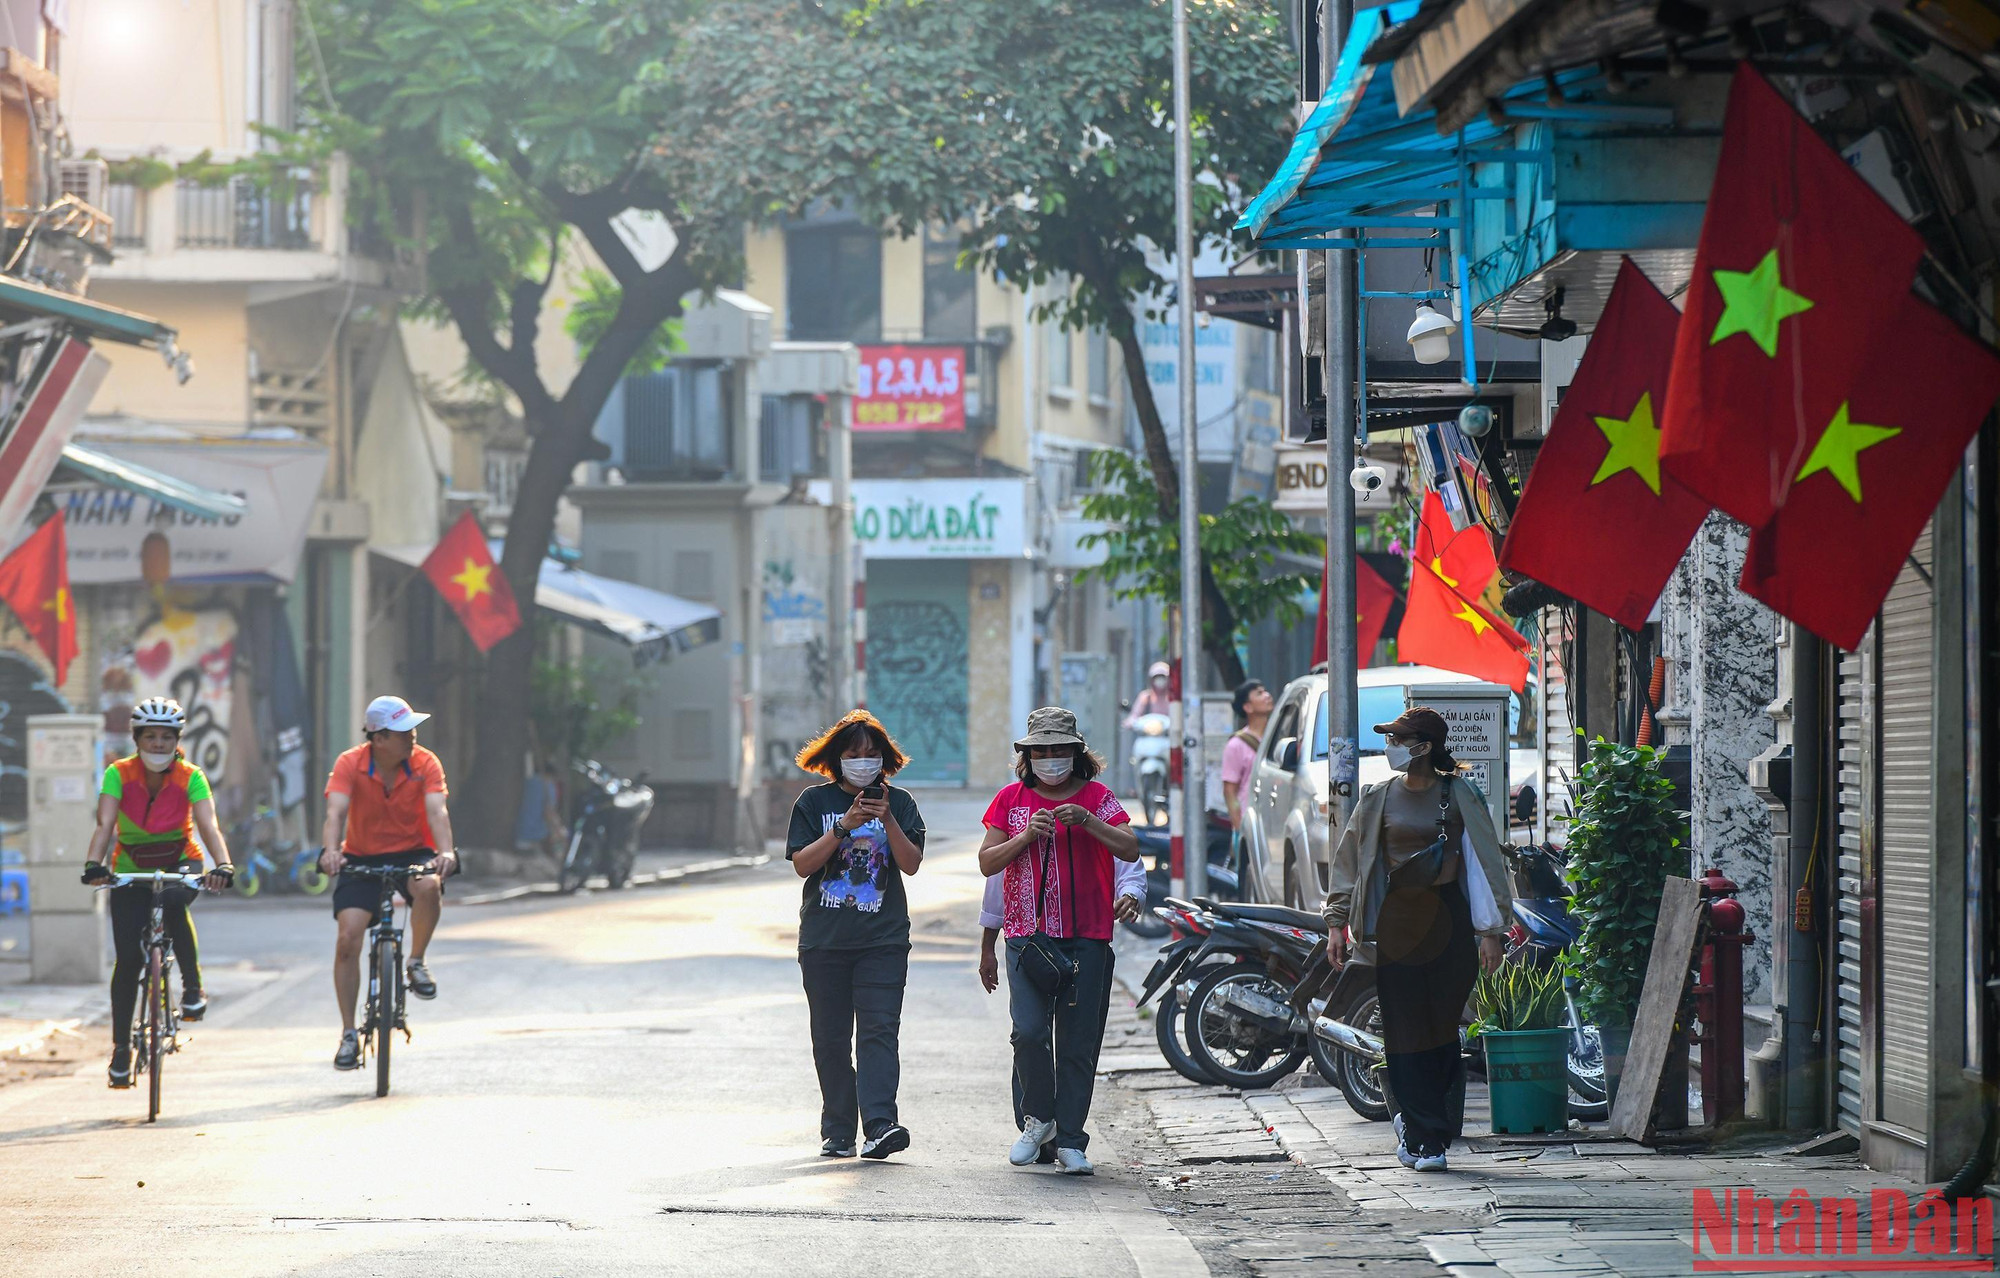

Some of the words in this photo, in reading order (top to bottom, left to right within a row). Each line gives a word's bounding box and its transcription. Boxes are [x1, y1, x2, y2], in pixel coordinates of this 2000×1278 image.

[945, 491, 997, 539] ĐẤT
[1459, 711, 1472, 724] LẠI
[1477, 771, 1485, 779] 14
[819, 890, 841, 909] THE
